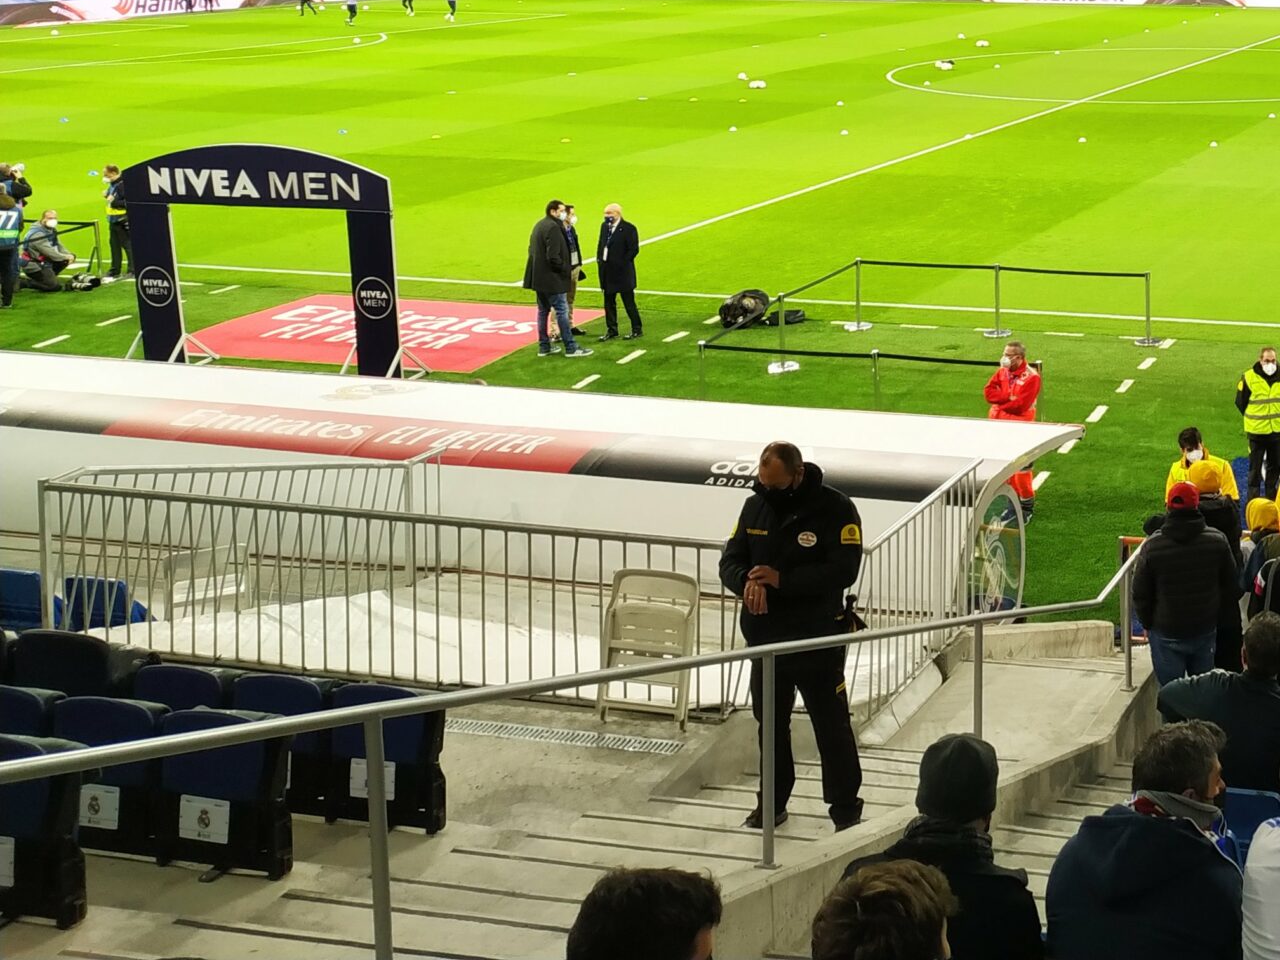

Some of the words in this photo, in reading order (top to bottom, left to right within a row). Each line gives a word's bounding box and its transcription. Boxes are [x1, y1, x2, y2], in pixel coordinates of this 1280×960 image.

[147, 165, 261, 199] NIVEA
[267, 171, 361, 202] MEN
[142, 278, 170, 288] NIVEA
[145, 287, 168, 296] MEN
[360, 289, 388, 299] NIVEA
[363, 299, 386, 308] MEN
[169, 408, 374, 440] Emirates
[373, 426, 448, 446] FLY
[429, 430, 557, 455] BETTER
